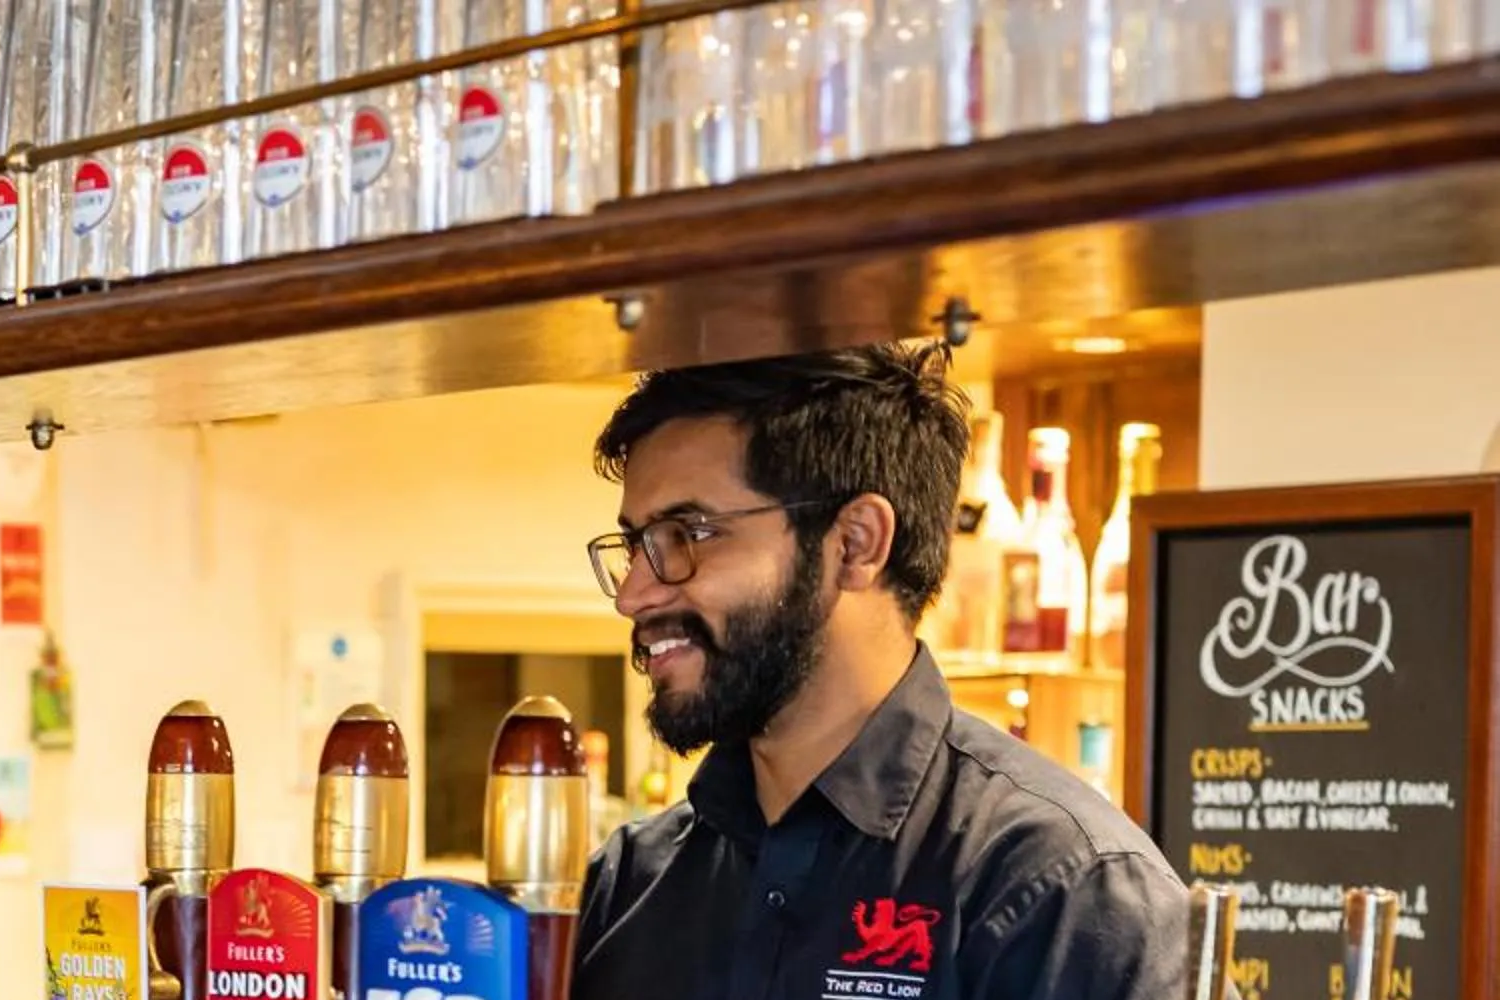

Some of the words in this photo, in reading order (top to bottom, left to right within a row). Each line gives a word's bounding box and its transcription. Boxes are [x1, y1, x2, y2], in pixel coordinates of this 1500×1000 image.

[1204, 534, 1392, 672] Bar
[1251, 685, 1366, 723] SNACKS
[60, 953, 127, 980] GOLDEN
[209, 970, 306, 1000] LONDON
[826, 977, 854, 993] THE
[856, 980, 883, 995] RED
[887, 982, 922, 997] LION
